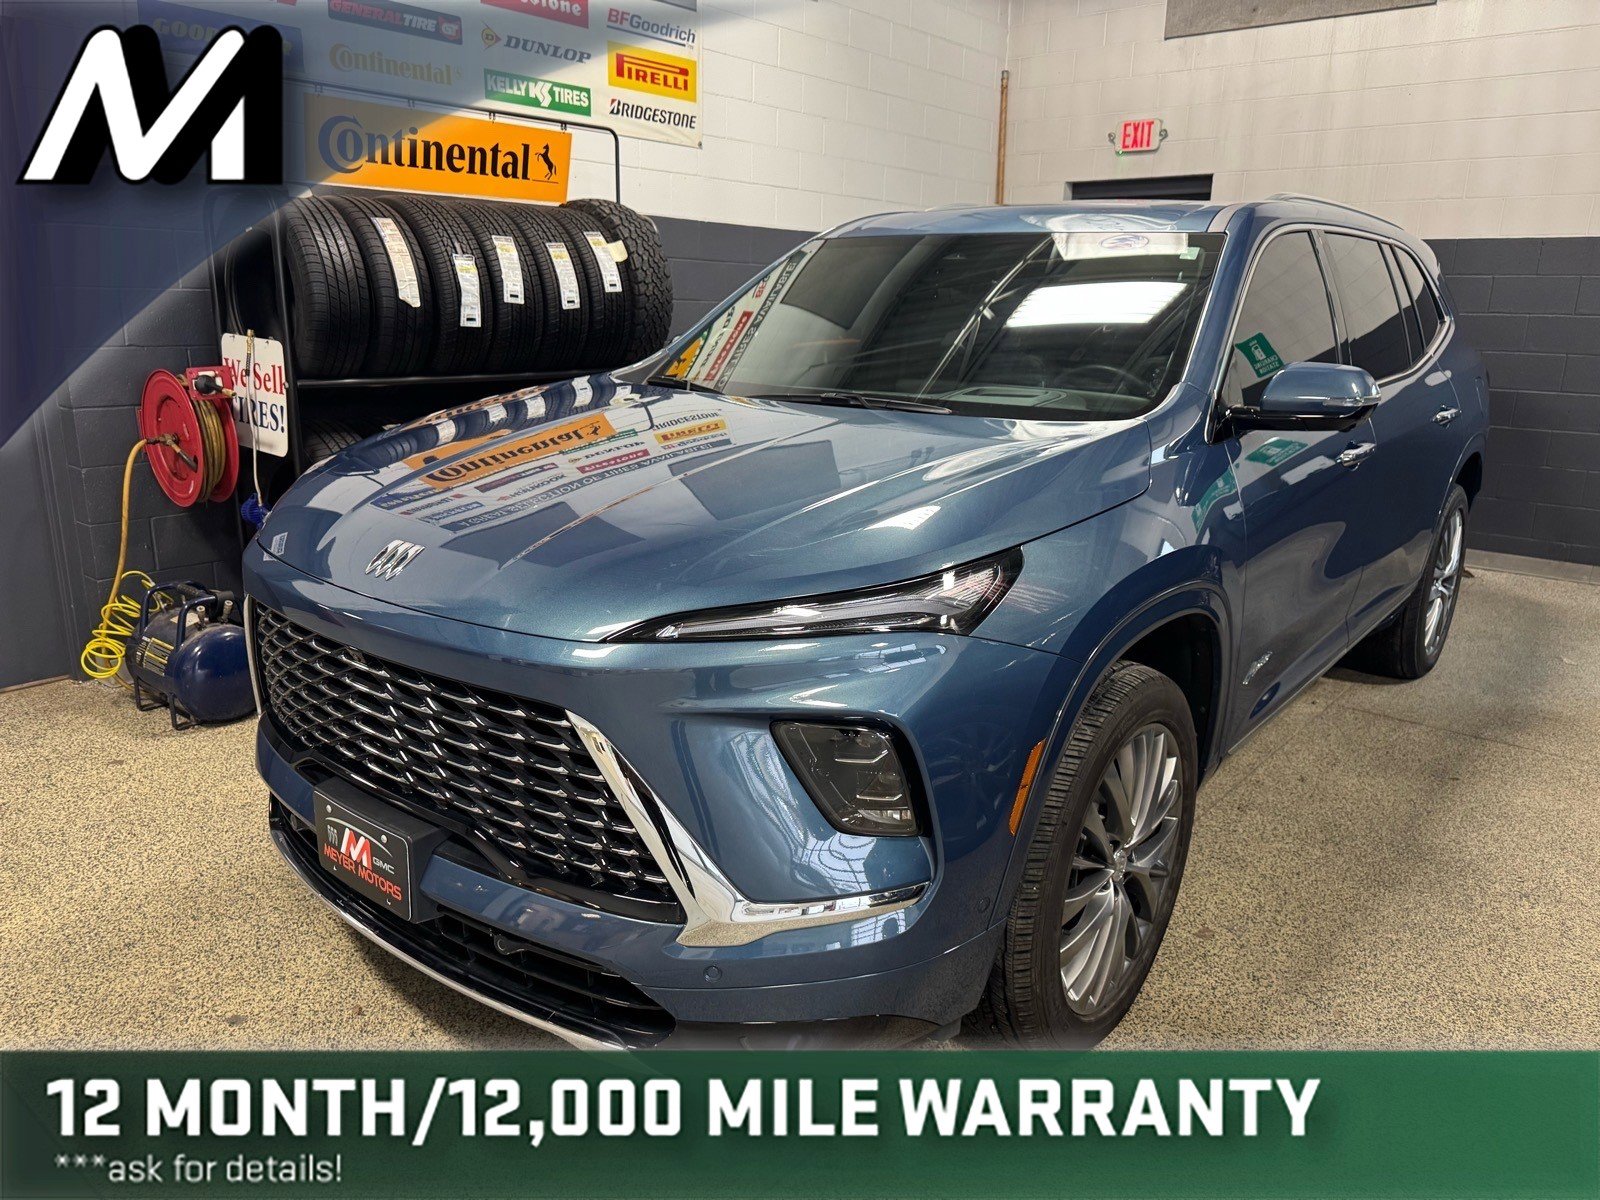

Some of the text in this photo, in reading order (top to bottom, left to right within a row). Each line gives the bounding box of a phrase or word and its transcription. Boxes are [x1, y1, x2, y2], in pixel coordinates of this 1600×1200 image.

[330, 0, 402, 26] GENERAL
[403, 13, 437, 32] TIRE
[607, 8, 696, 44] BFGoodrich
[329, 43, 453, 85] Continental
[504, 34, 592, 64] DUNLOP
[616, 53, 690, 92] PIRELLI
[487, 74, 528, 96] KELLY
[553, 86, 590, 108] TIRES
[608, 98, 697, 129] BRIDGESTONE
[318, 115, 531, 181] Continental
[1122, 121, 1154, 149] EXIT
[253, 362, 285, 395] Sell
[232, 396, 285, 434] IRES!
[323, 843, 403, 901] MEYER MOTORS
[372, 856, 396, 875] GMC
